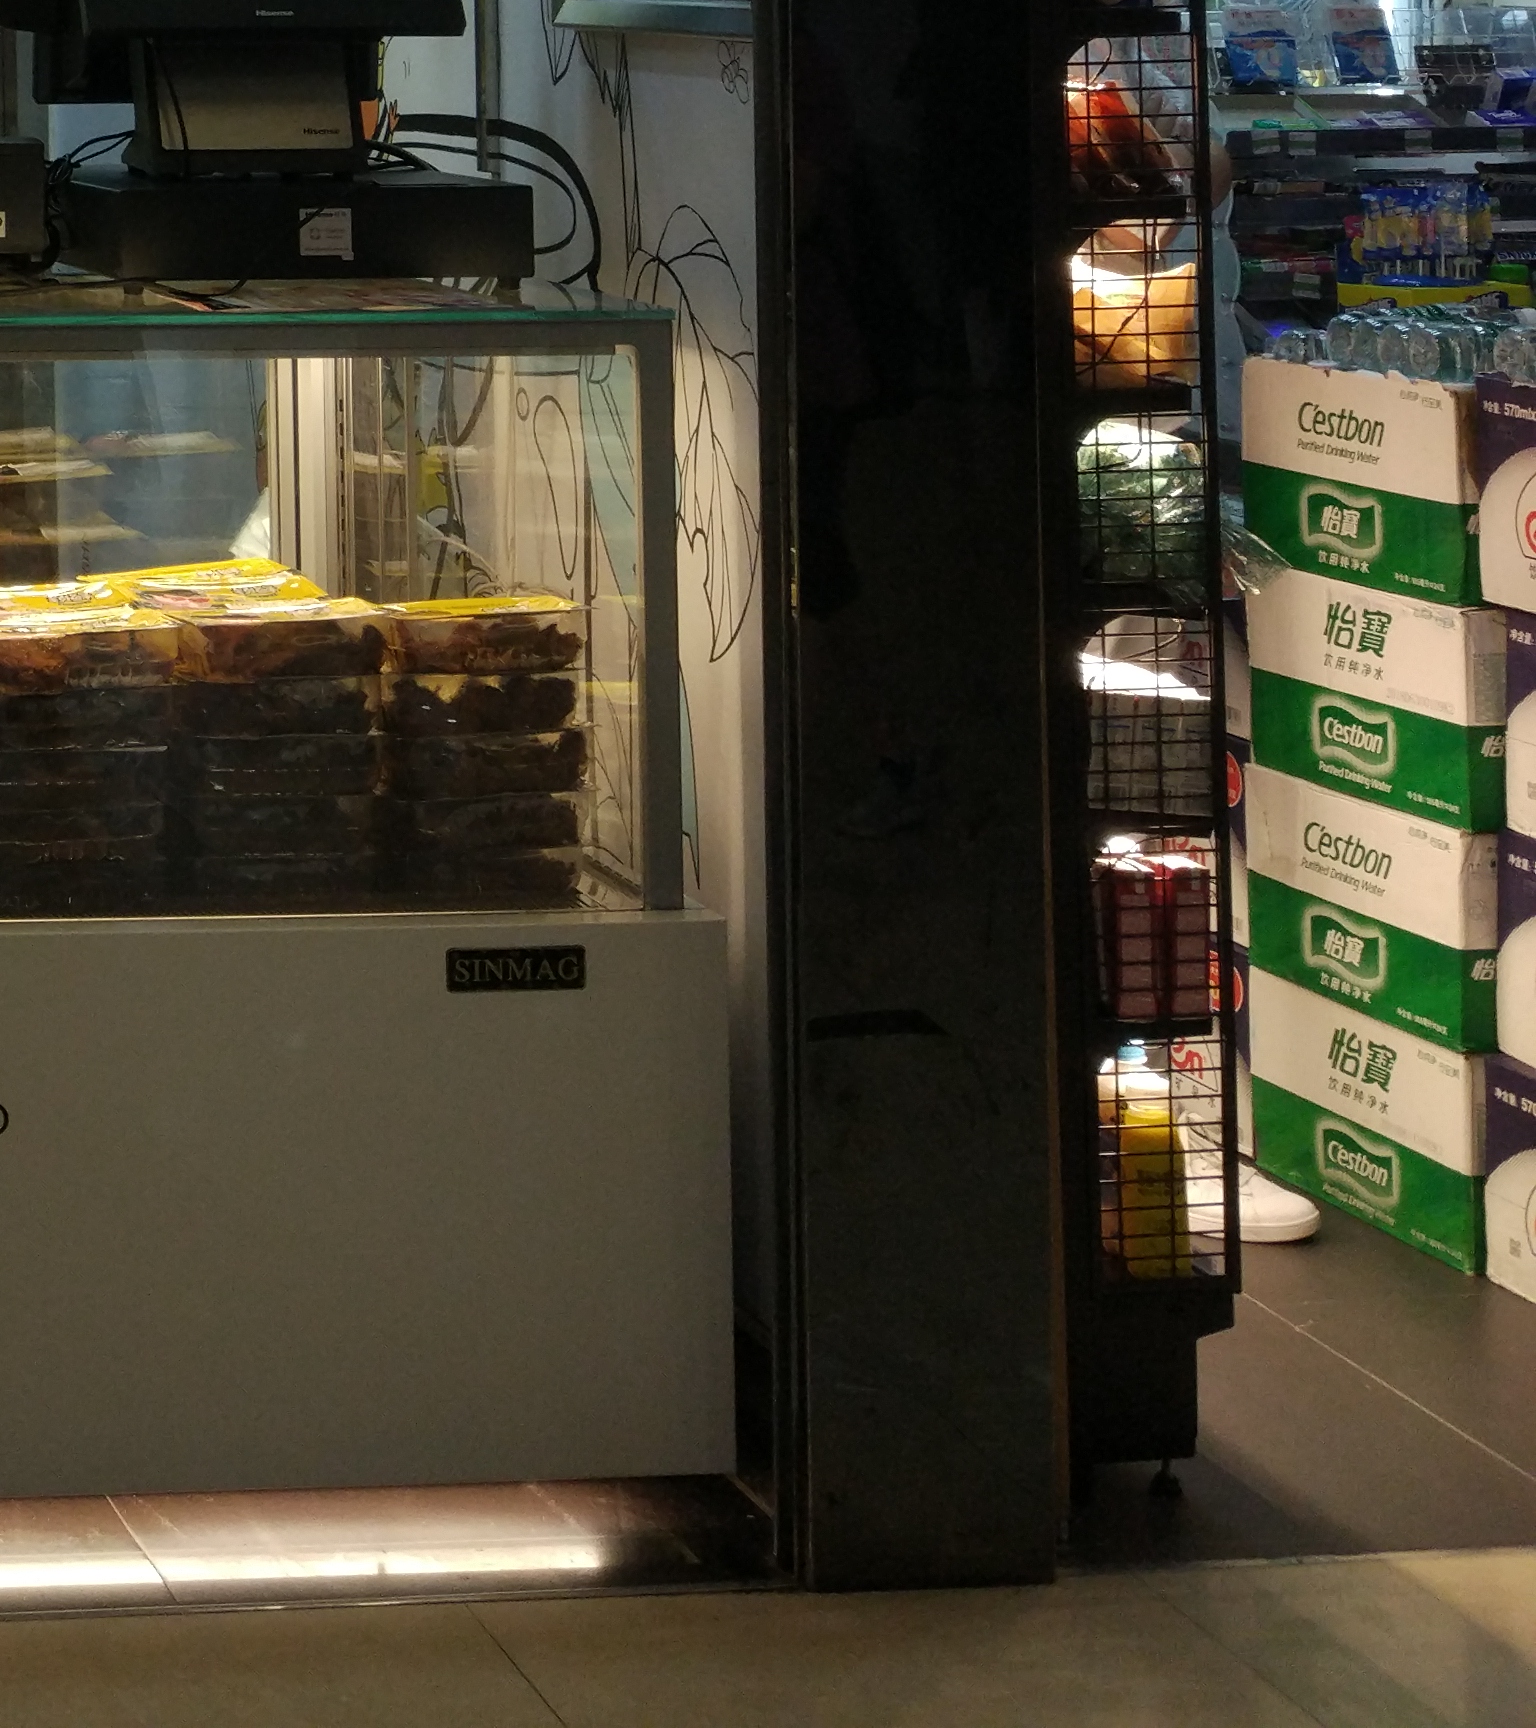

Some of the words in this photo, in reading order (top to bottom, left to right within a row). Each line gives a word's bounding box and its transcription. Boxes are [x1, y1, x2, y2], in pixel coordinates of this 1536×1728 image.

[255, 8, 295, 18] Hisense
[302, 126, 341, 136] Hisense
[1320, 504, 1360, 540] 怡寶
[1324, 601, 1393, 659] 怡寶
[1323, 928, 1365, 970] 怡寶
[453, 955, 580, 983] SINMAG
[1328, 1027, 1398, 1095] 怡寶
